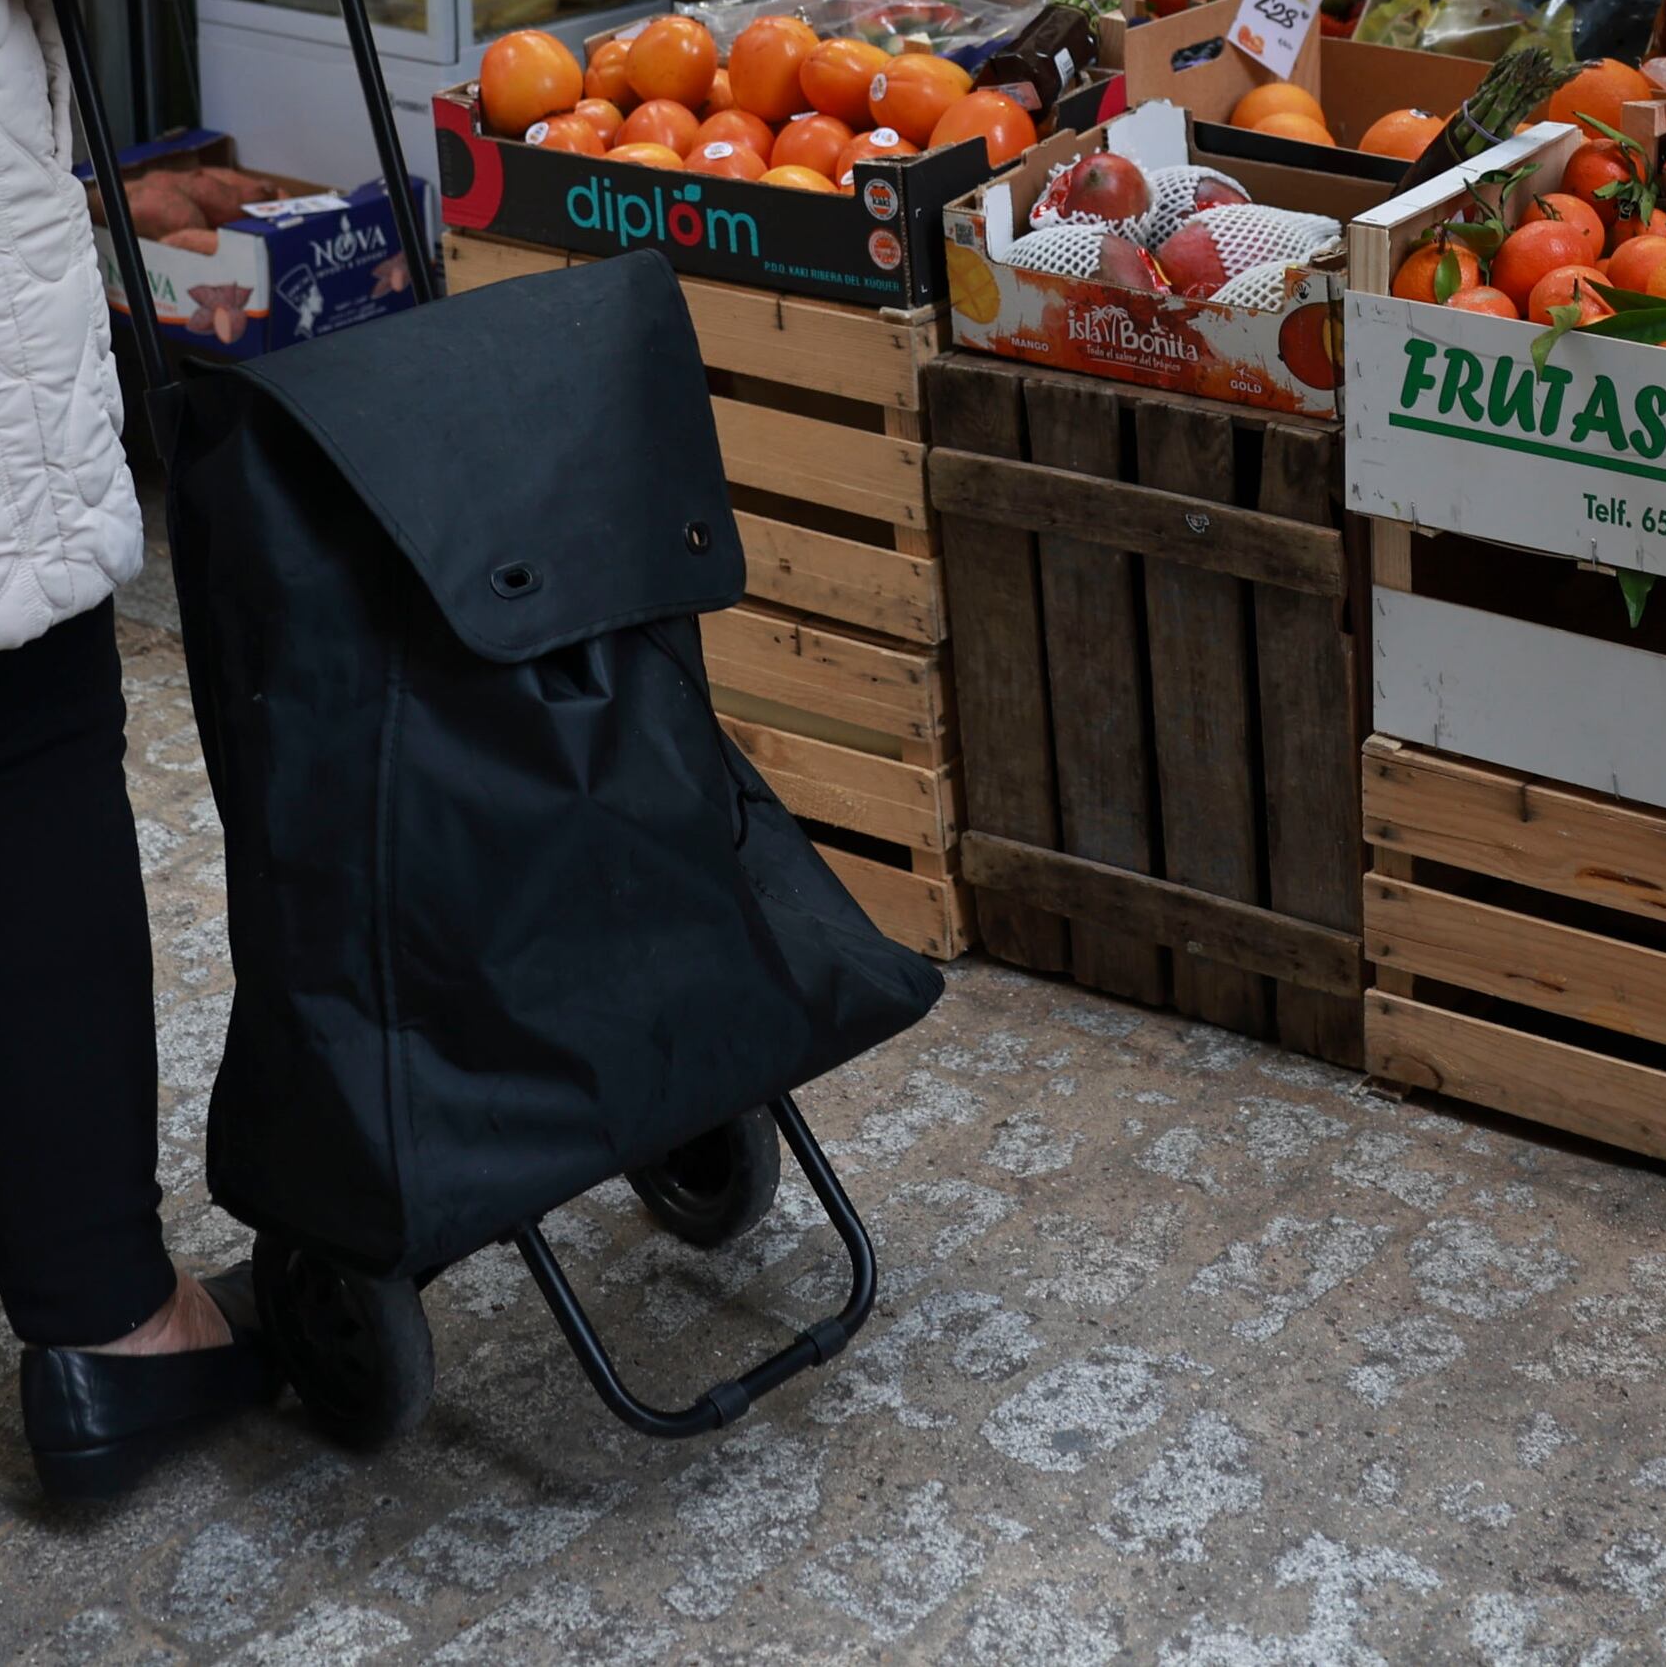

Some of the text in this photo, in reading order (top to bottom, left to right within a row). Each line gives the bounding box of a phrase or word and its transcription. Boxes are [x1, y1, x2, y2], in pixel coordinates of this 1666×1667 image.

[310, 223, 387, 269] NOVA
[788, 265, 809, 276] KAKI
[810, 269, 844, 284] RIBERA
[844, 273, 861, 287] DEL
[1011, 336, 1050, 353] MANGO
[1067, 309, 1200, 362] isla Bonita
[1086, 344, 1105, 357] Todo
[1106, 348, 1114, 359] el
[1115, 350, 1137, 363] sabor
[1138, 353, 1152, 367] del
[1229, 379, 1263, 395] GOLD
[1583, 493, 1633, 530] Telf.
